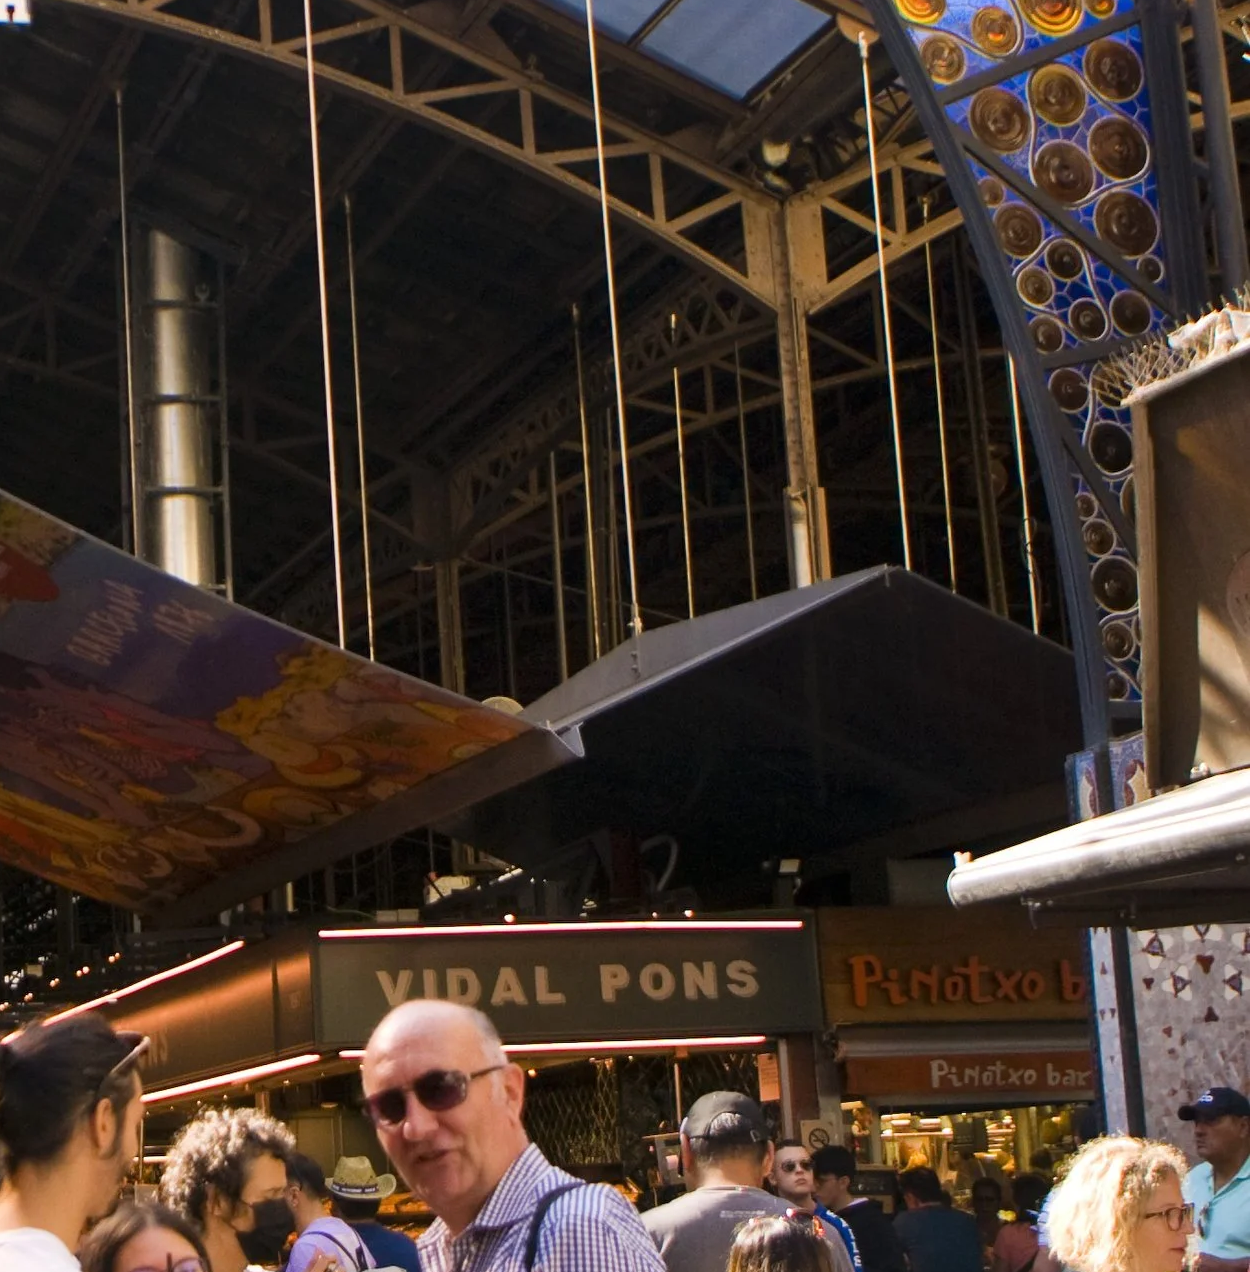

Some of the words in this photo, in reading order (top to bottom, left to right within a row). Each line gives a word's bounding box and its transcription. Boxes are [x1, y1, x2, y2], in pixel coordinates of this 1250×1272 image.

[375, 965, 566, 1007] VIDAL
[599, 959, 760, 1003] PONS
[1046, 1063, 1091, 1088] bar
